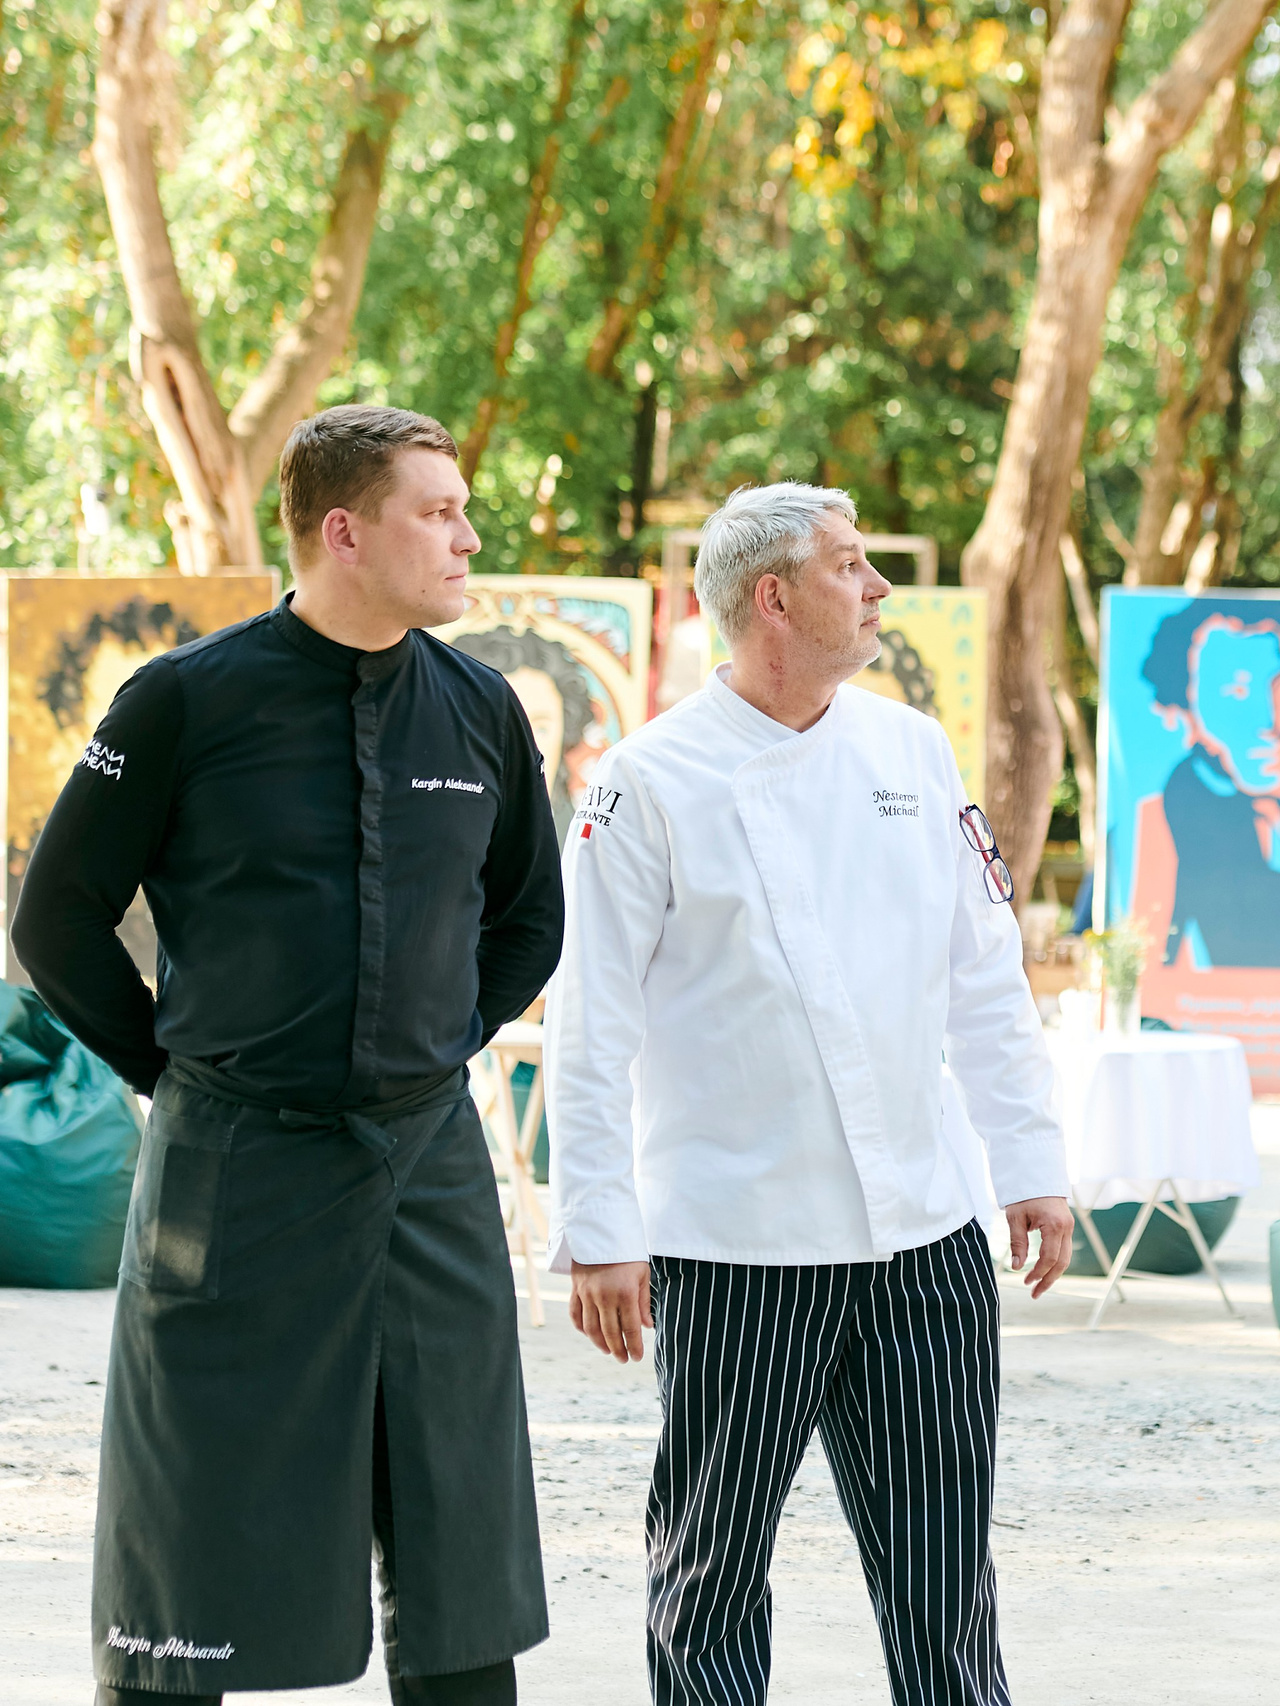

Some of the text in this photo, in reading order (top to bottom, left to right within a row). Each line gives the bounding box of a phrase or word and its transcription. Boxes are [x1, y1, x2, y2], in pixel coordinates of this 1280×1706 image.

[411, 778, 485, 794] Kargin Aleksandr
[872, 789, 919, 803] Nesterov
[878, 803, 919, 818] Michail
[106, 1625, 235, 1659] Kargin Aleksandr
